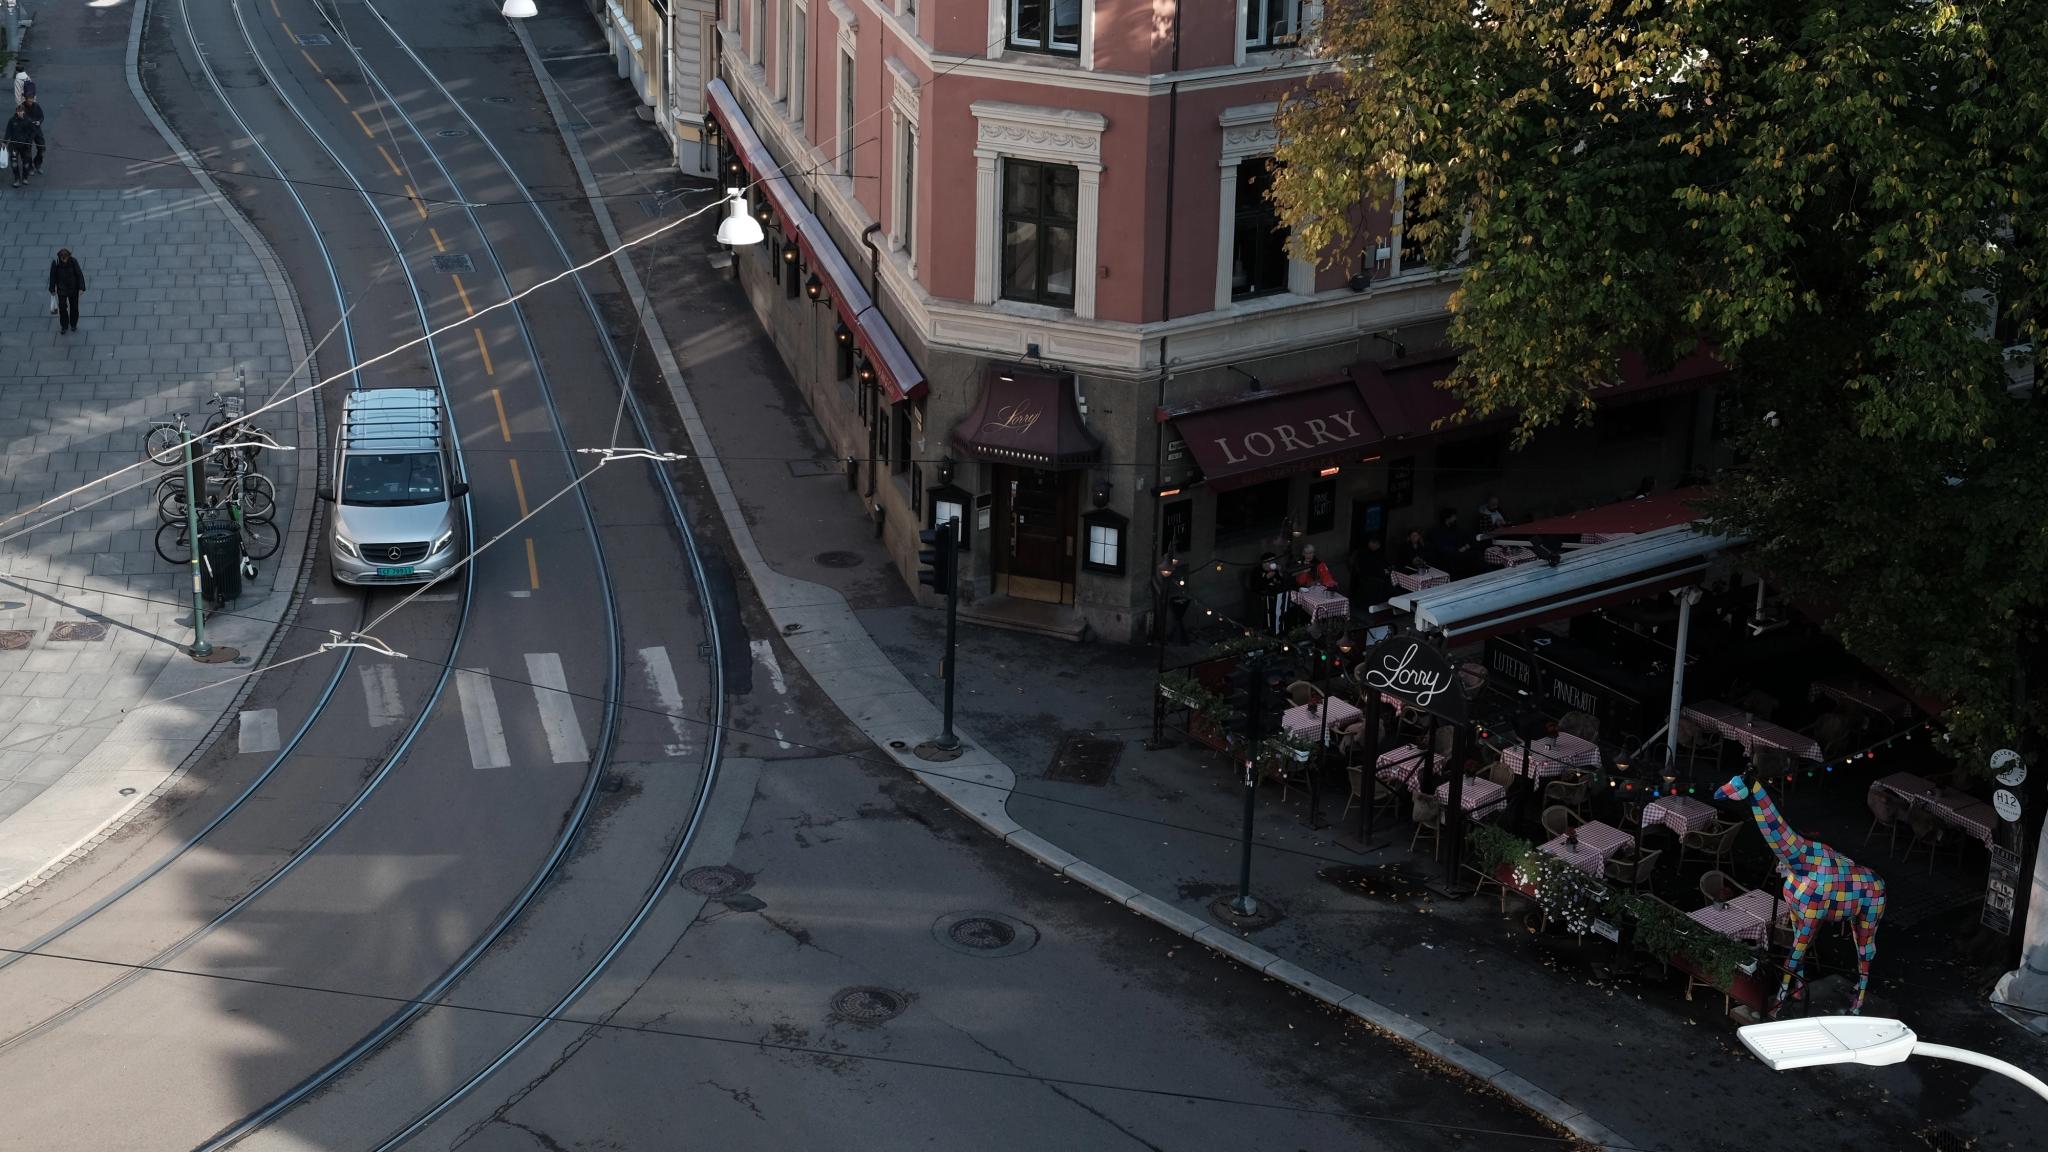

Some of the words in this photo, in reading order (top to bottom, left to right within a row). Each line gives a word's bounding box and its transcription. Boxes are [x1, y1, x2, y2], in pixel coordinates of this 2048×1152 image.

[983, 399, 1042, 434] Lorry
[1214, 410, 1361, 464] LORRY
[1366, 644, 1453, 706] Lorry
[1996, 791, 2017, 807] H12
